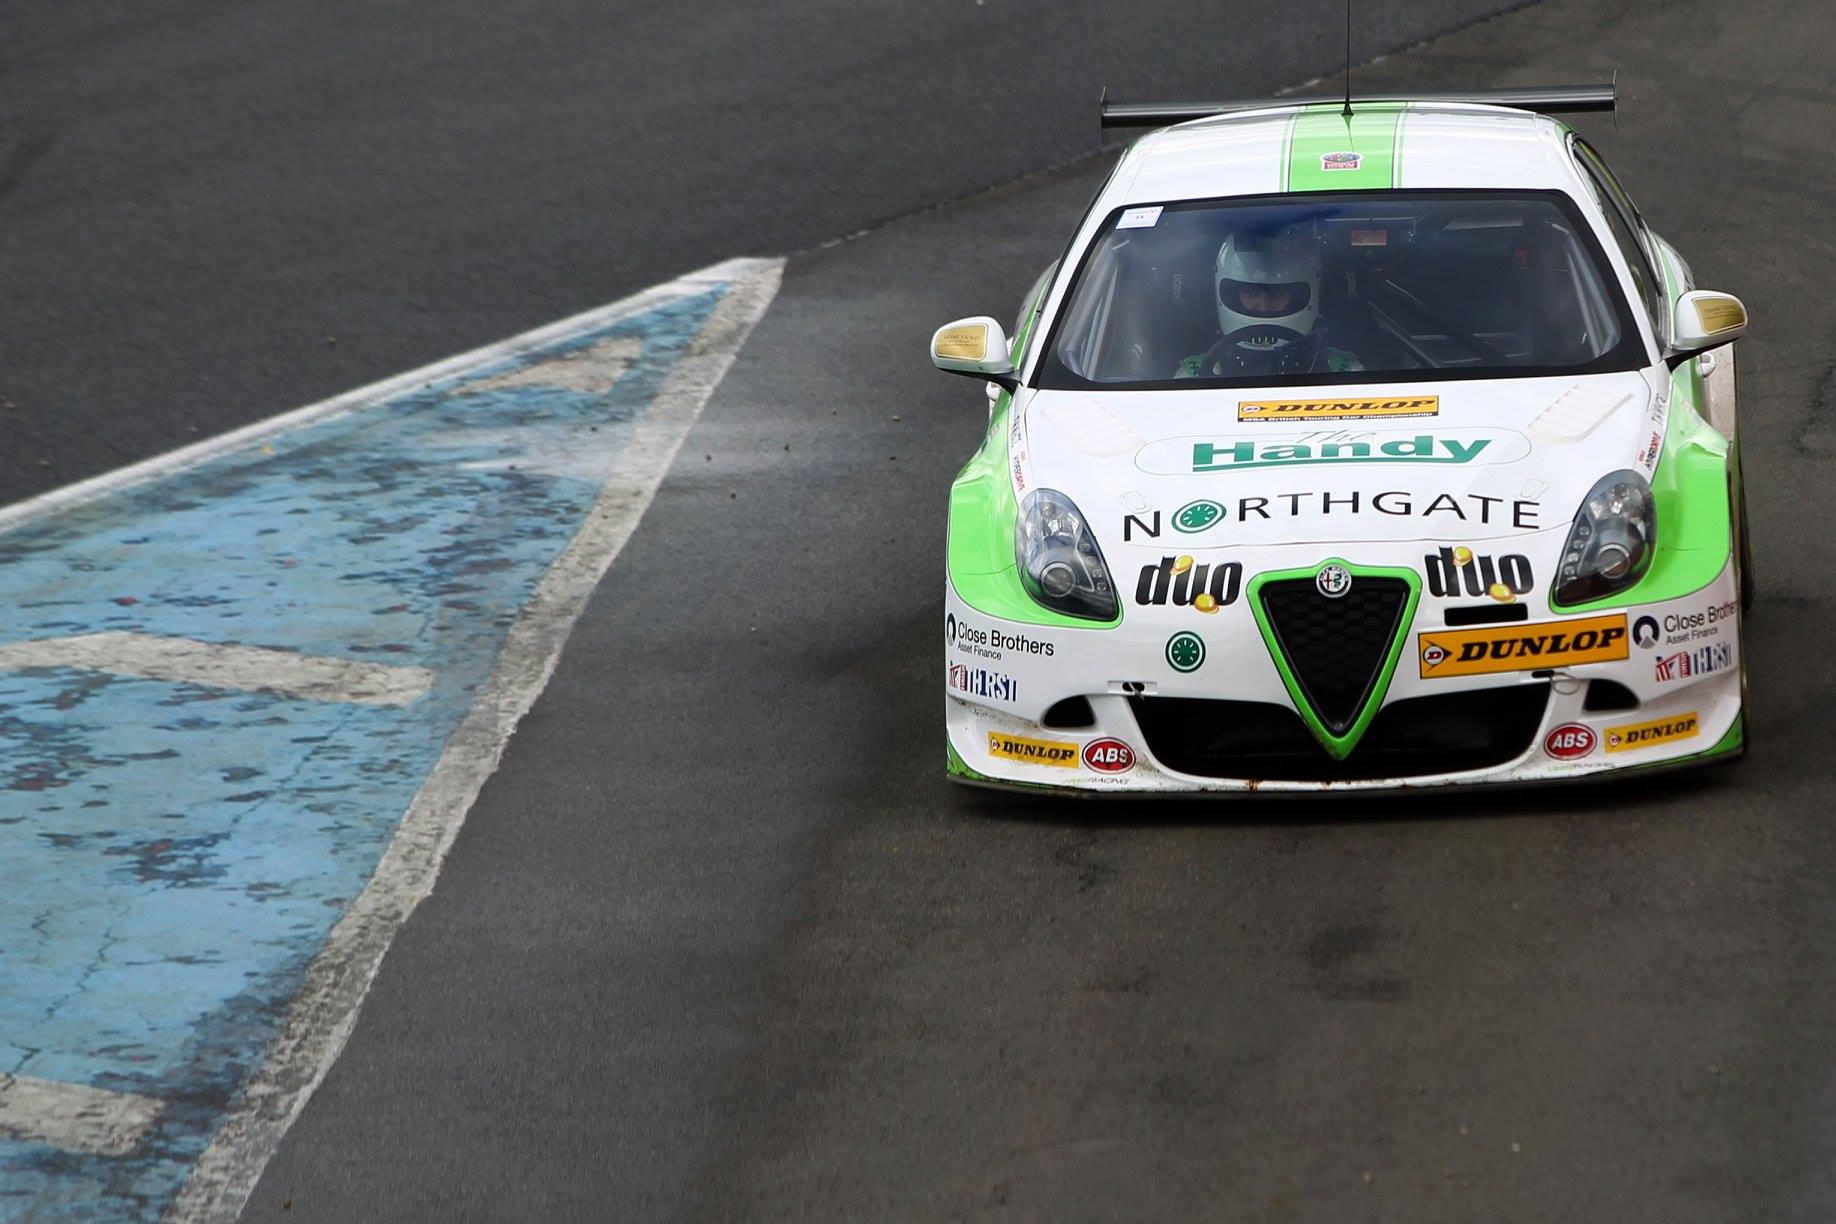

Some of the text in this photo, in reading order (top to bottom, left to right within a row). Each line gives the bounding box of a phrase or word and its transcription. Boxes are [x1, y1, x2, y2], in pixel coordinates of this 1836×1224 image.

[1273, 400, 1436, 412] DUNLOP
[1193, 435, 1492, 470] Handy
[1135, 555, 1243, 609] duo
[1424, 546, 1535, 600] duo
[1664, 613, 1705, 633] Close
[957, 621, 1055, 656] Close Brothers
[1456, 627, 1625, 662] DUNLOP
[1666, 627, 1719, 645] Asset Finance
[957, 641, 1002, 660] Asset Finance
[1552, 732, 1588, 750] ABS
[1626, 719, 1696, 744] DUNLOP
[1003, 741, 1074, 761] DUNLOP
[1092, 747, 1128, 763] ABS
